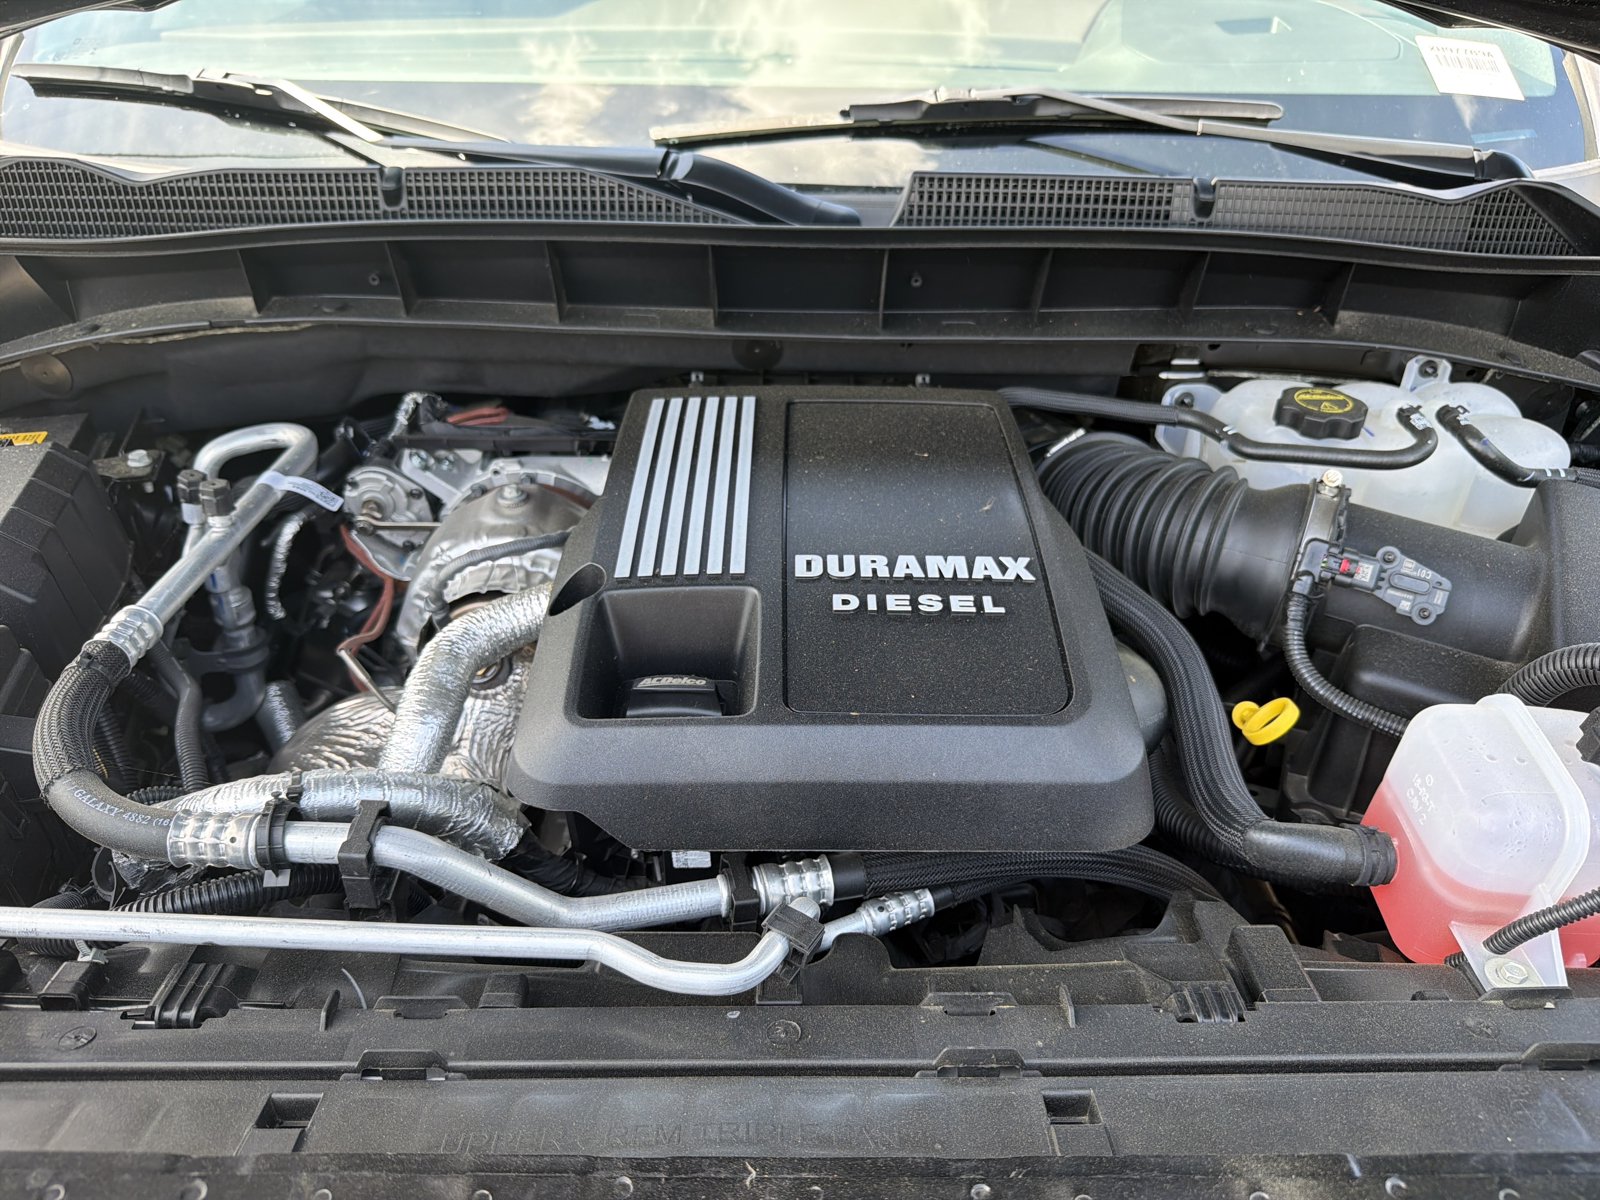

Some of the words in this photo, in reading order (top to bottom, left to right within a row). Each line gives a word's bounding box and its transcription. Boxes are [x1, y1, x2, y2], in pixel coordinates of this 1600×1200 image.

[794, 554, 1036, 583] DURAMAX
[832, 593, 1006, 614] DIESEL
[637, 676, 707, 688] ACDelco
[74, 789, 124, 817] GALAXY
[123, 811, 151, 825] 4882
[152, 817, 173, 828] (16
